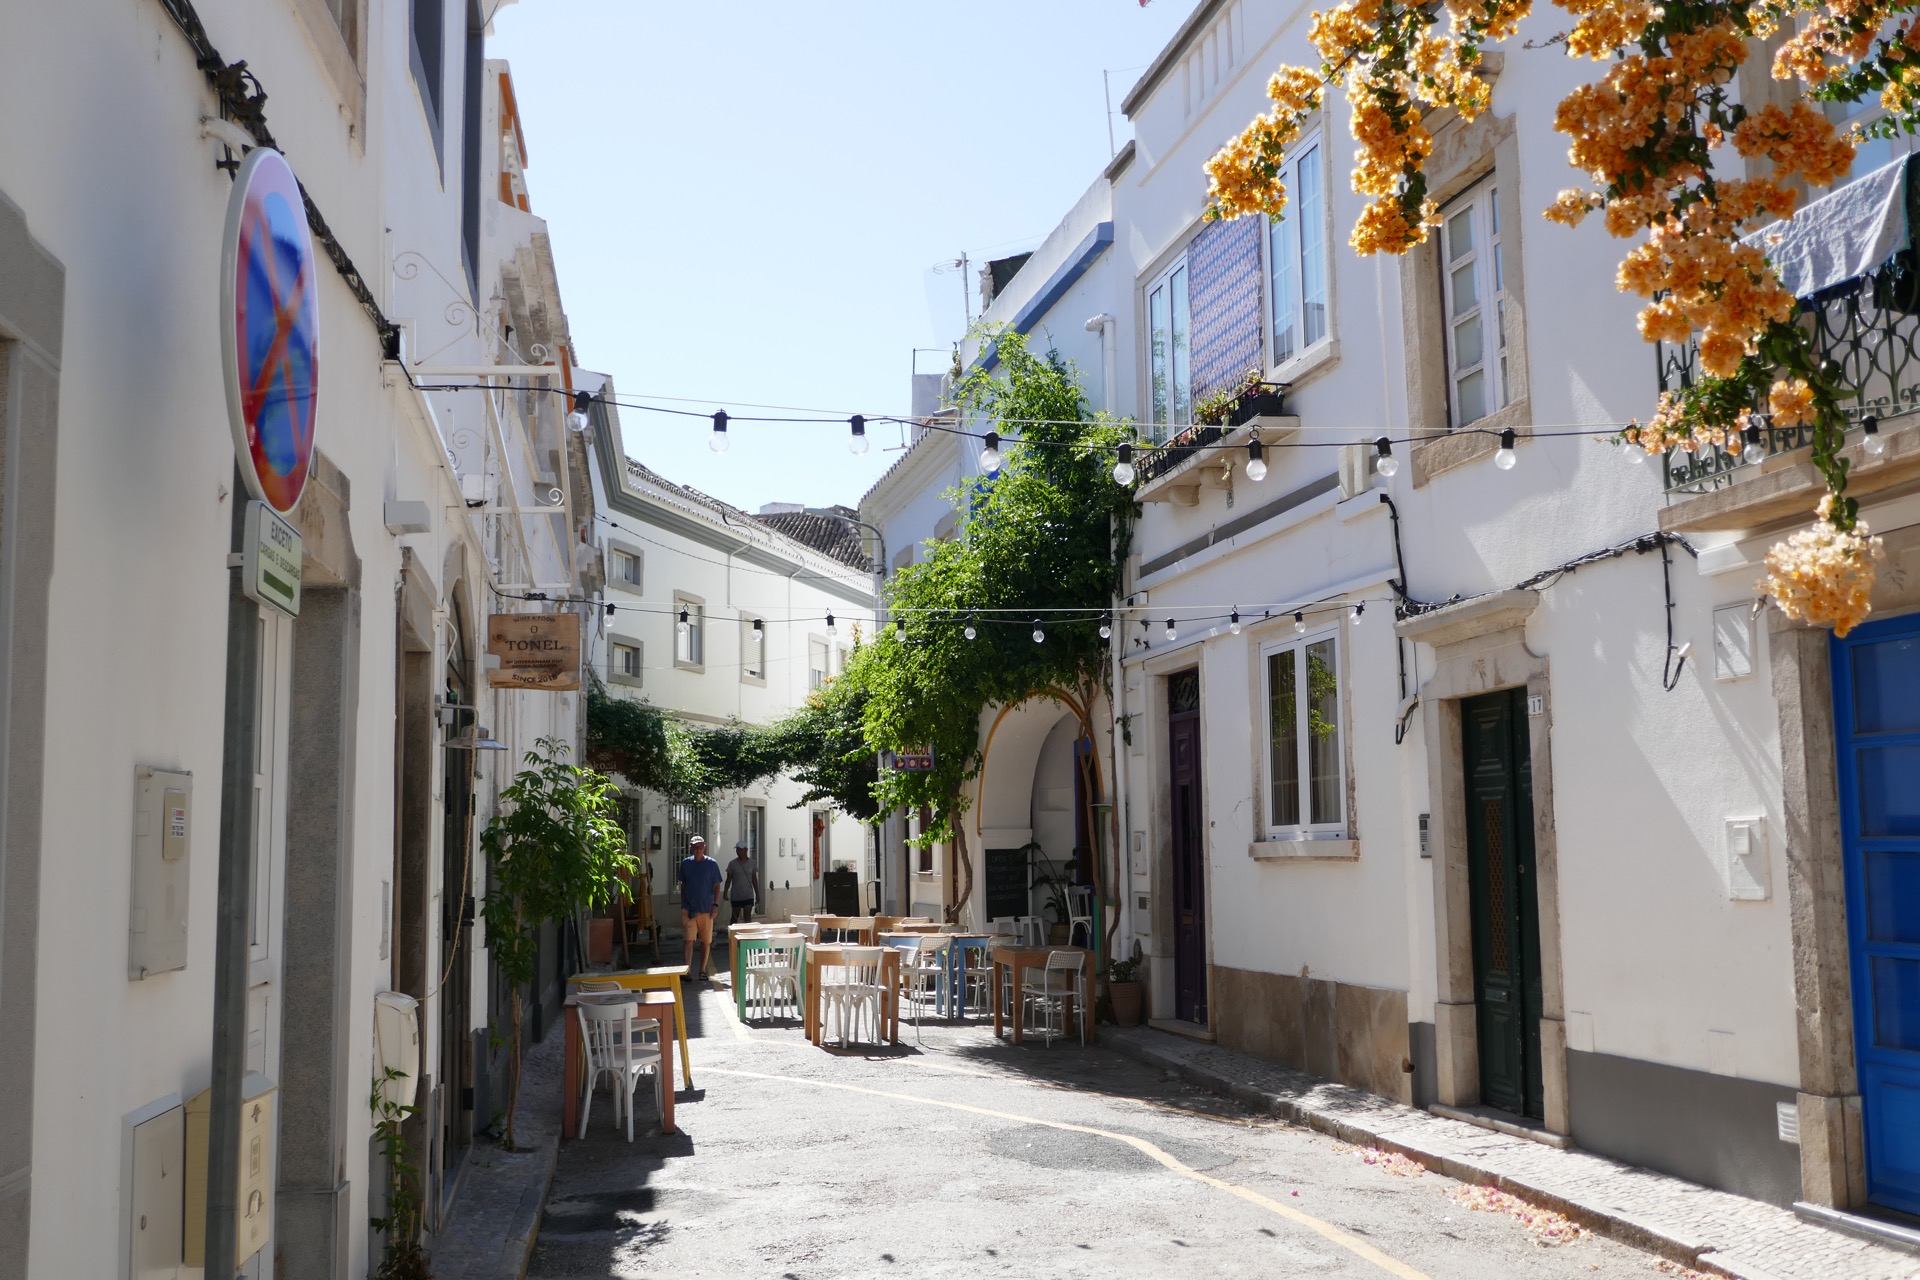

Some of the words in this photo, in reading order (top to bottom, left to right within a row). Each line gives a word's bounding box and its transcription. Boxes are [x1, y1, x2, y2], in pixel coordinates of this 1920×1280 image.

[271, 520, 293, 553] EXCETO
[537, 615, 556, 623] FOOD
[530, 625, 538, 634] O
[505, 640, 564, 651] TONEL
[512, 674, 536, 683] SINCE
[1532, 699, 1542, 712] 17
